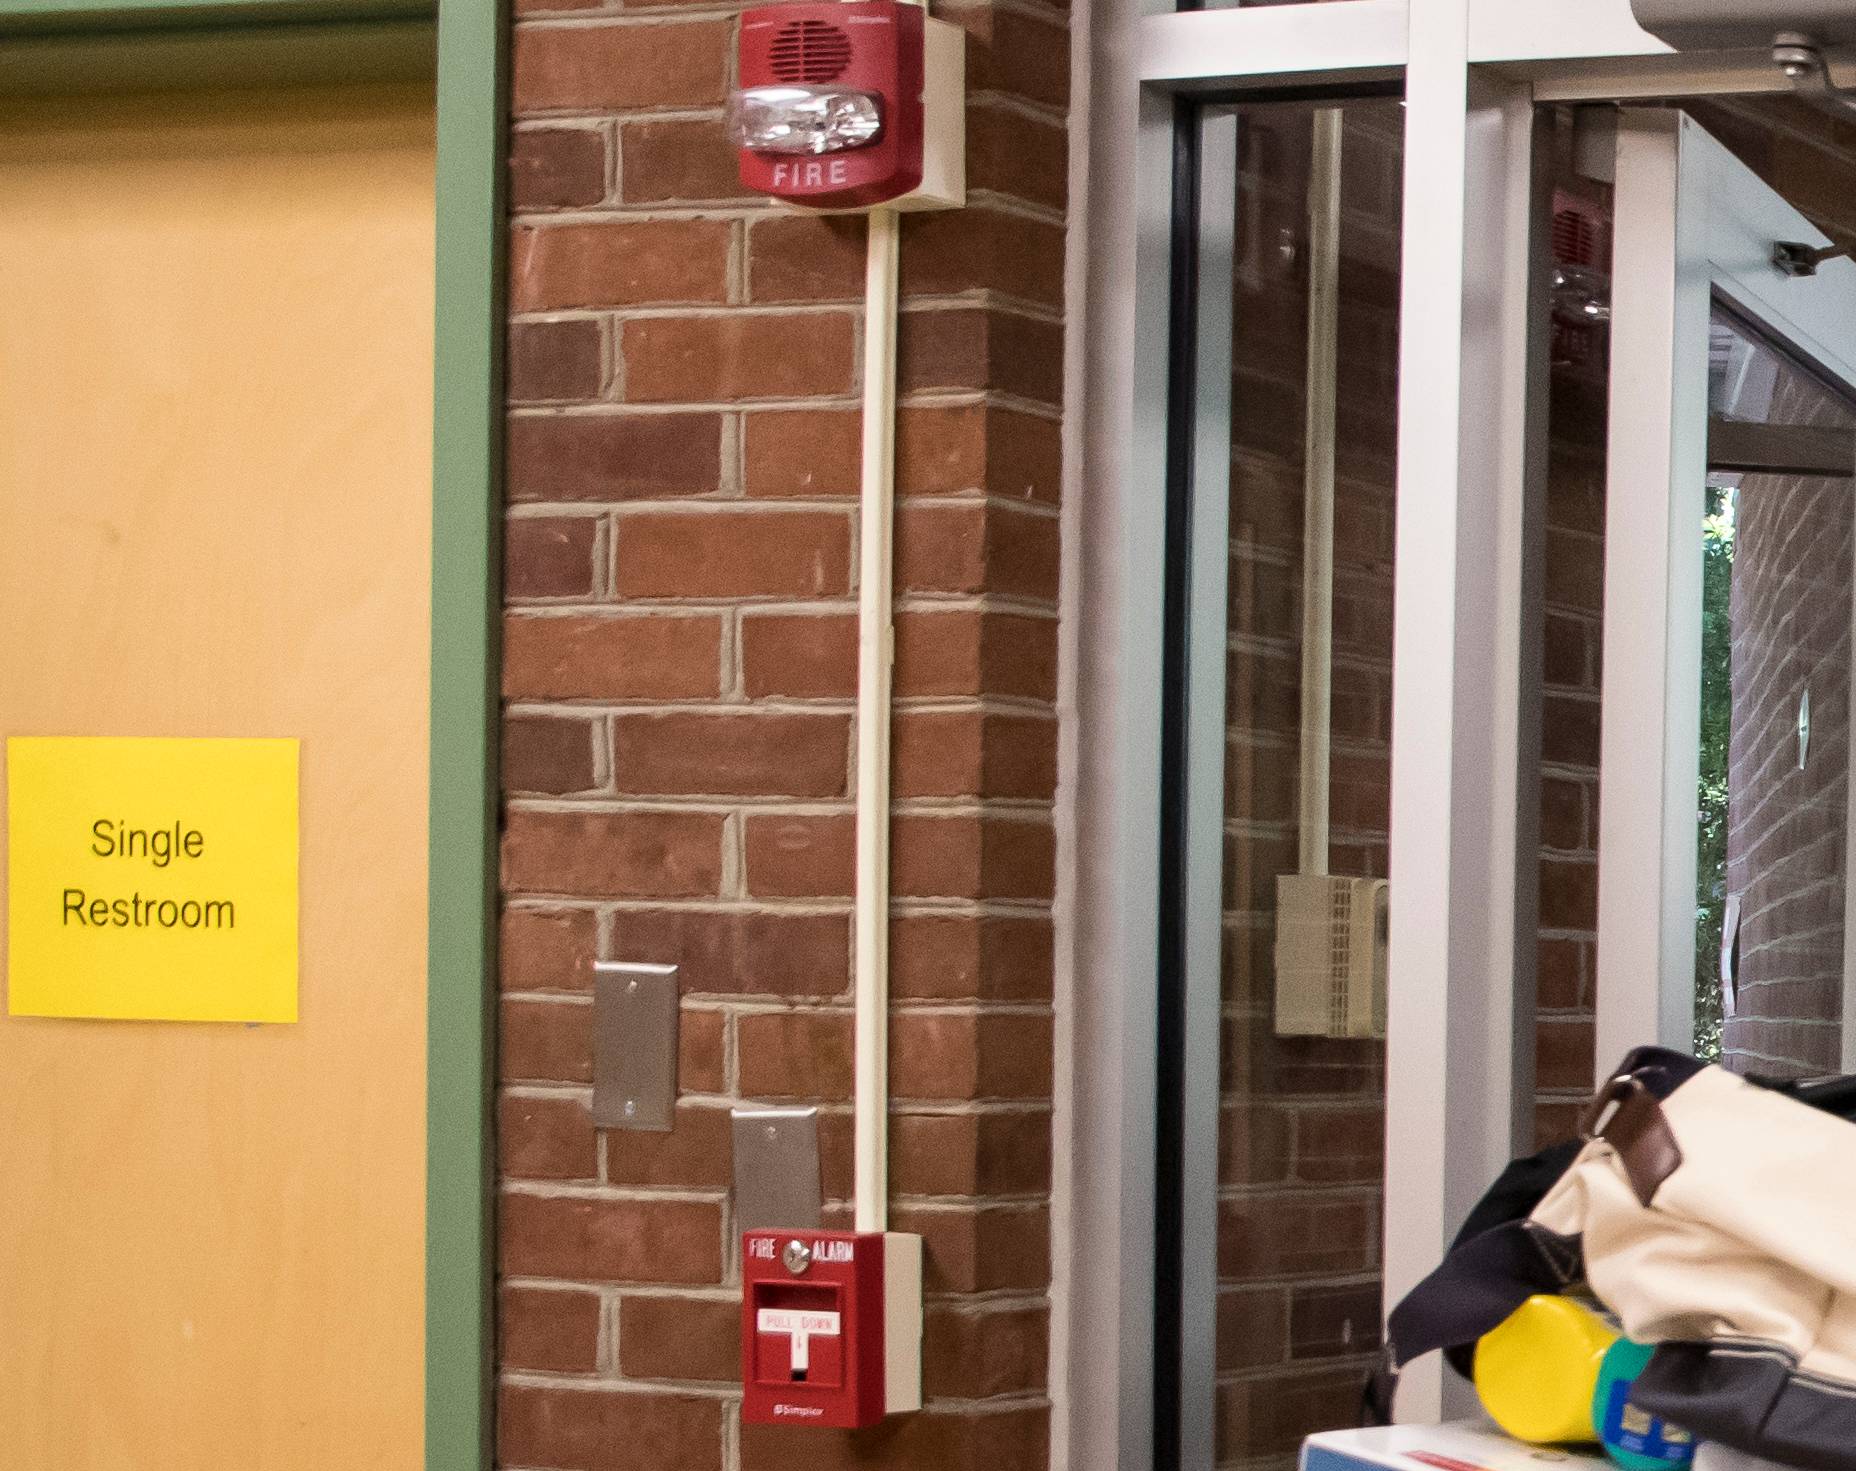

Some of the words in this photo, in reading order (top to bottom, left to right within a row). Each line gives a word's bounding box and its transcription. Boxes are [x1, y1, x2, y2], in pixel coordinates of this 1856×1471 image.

[773, 160, 848, 188] FIRE
[91, 819, 204, 868] Single
[62, 888, 235, 929] Restroom
[748, 1238, 776, 1259] FIRE
[812, 1240, 854, 1261] ALARM
[766, 1315, 792, 1329] PULL
[801, 1316, 833, 1330] DOWN
